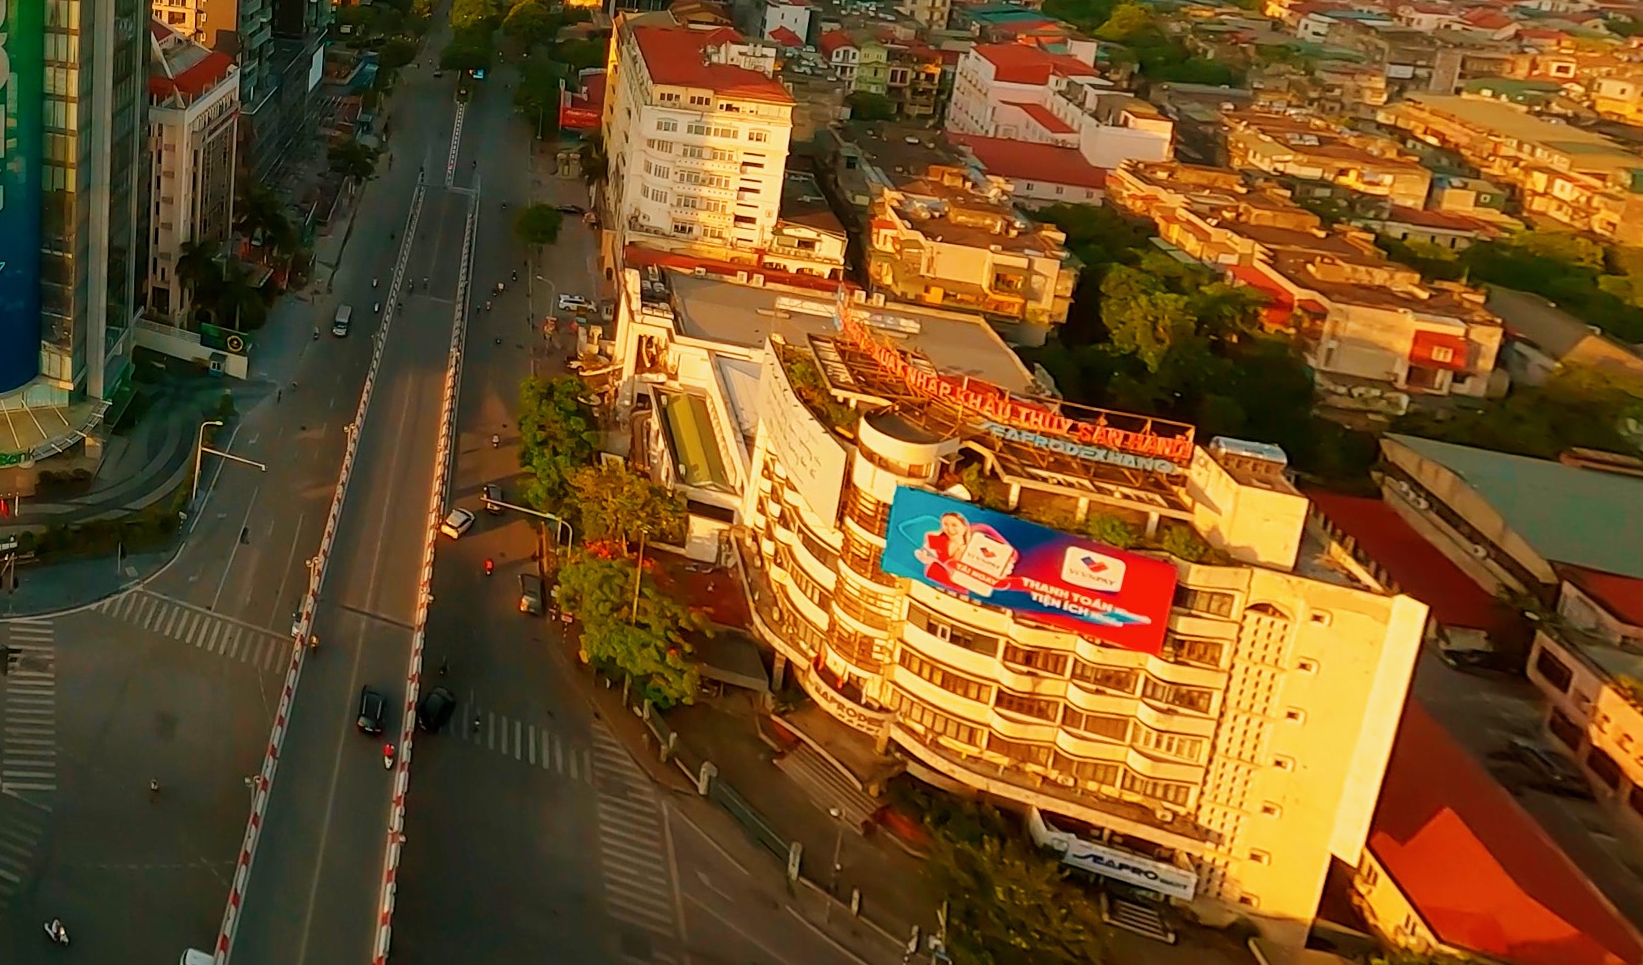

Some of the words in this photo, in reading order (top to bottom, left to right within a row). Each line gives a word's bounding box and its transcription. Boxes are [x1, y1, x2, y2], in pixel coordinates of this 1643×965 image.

[1021, 576, 1070, 601] THANH
[1071, 591, 1115, 613] TOÁN
[1030, 590, 1061, 608] TIỆN
[1063, 600, 1089, 617] ÍCH
[1072, 853, 1159, 881] SEAPRO
